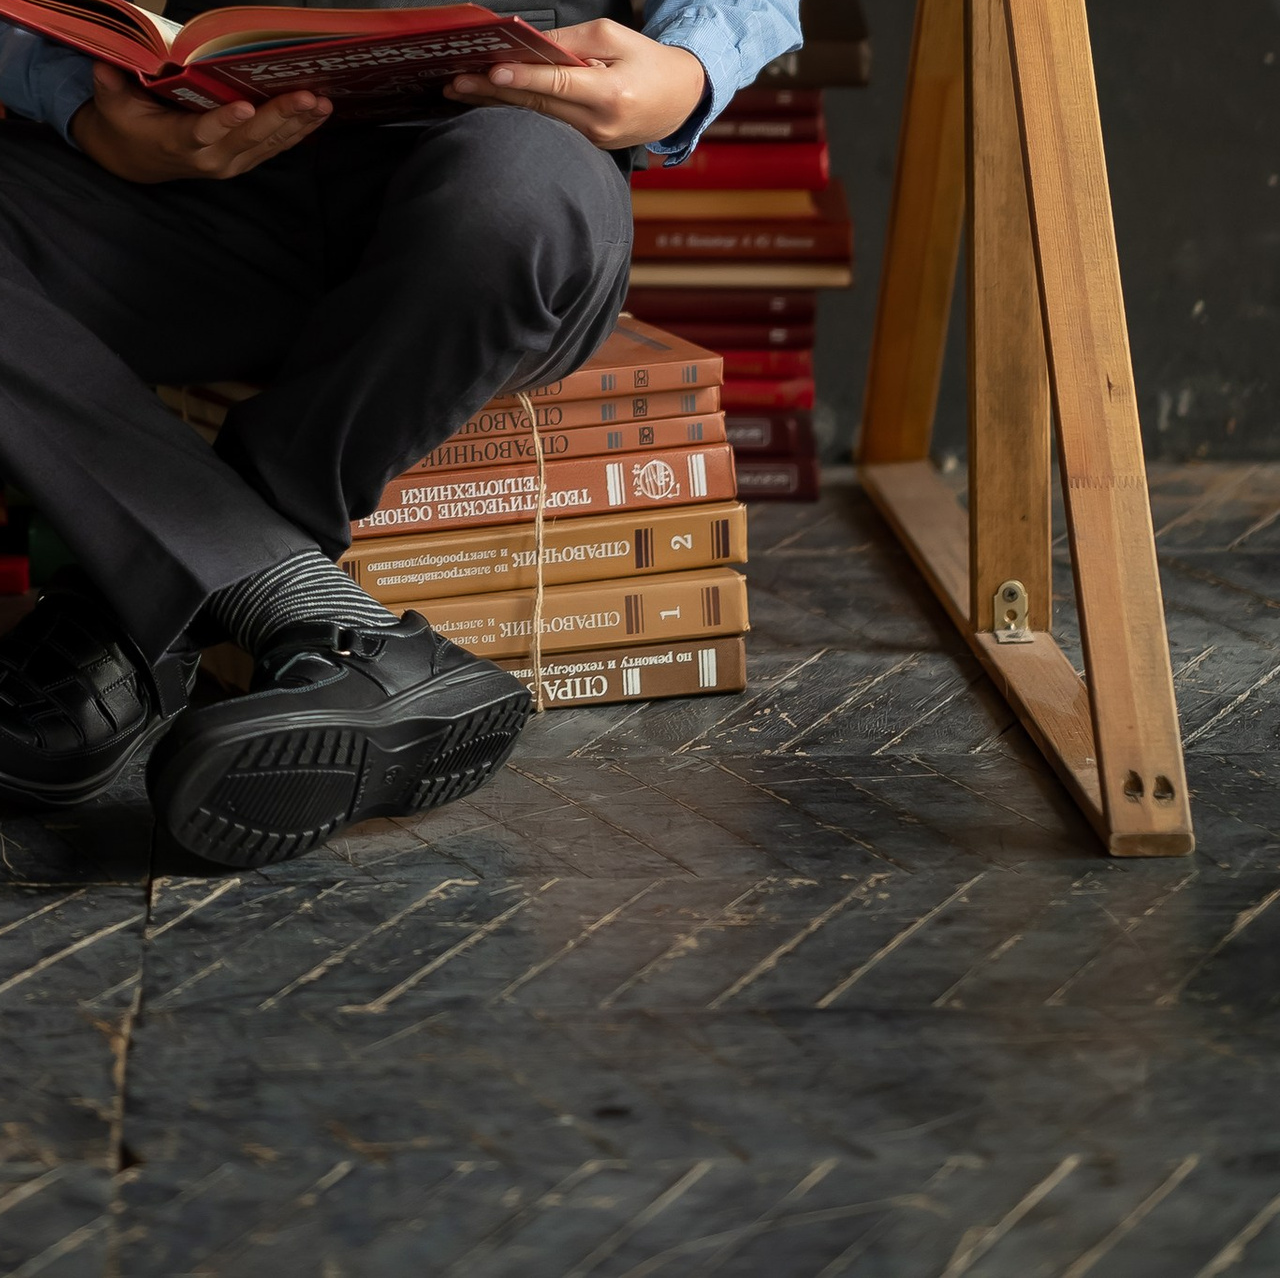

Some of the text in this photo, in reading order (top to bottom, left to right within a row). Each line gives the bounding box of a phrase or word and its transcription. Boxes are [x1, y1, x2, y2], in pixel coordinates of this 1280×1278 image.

[230, 36, 502, 74] Устройство
[251, 43, 512, 81] автомобиля
[422, 435, 568, 468] СПРАВОЧНИК
[401, 475, 547, 505] ТЕПЛОТЕХНИКИ
[358, 488, 592, 529] ТЕОРЕТИЧЕСКИЕ ОСНОВЫ
[670, 534, 693, 551] 2
[367, 547, 508, 574] и электрооборудованию
[376, 540, 630, 587] СПРАВОЧНИК по электроснабжению
[487, 618, 495, 627] и
[499, 610, 620, 638] СПРАВОЧНИК
[660, 605, 681, 620] 1
[481, 634, 495, 645] по
[606, 659, 616, 670] и
[620, 650, 673, 669] ремонту
[676, 651, 693, 663] по
